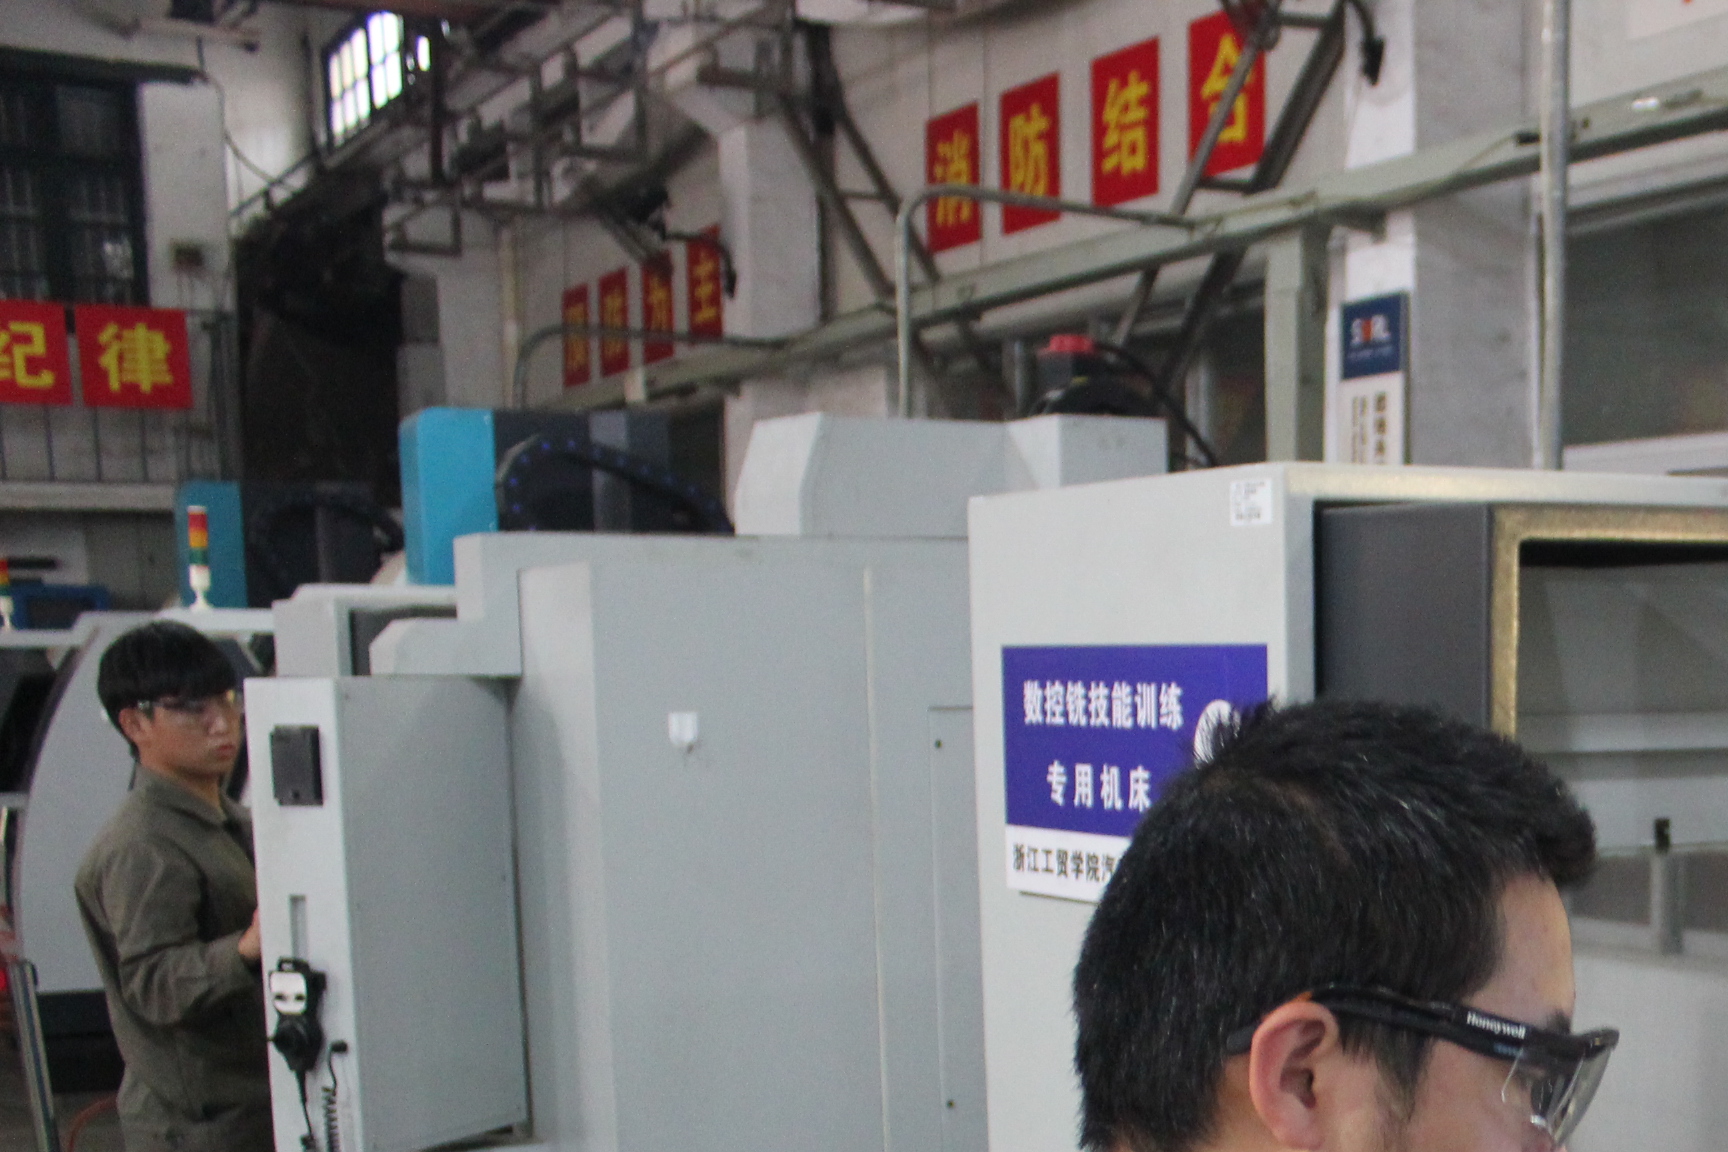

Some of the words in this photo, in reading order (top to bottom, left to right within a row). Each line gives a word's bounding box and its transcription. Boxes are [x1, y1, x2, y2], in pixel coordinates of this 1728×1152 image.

[1023, 679, 1183, 730] 数控铣技能训练
[1047, 760, 1152, 812] 专用机床
[1466, 1010, 1526, 1040] Honeywell
